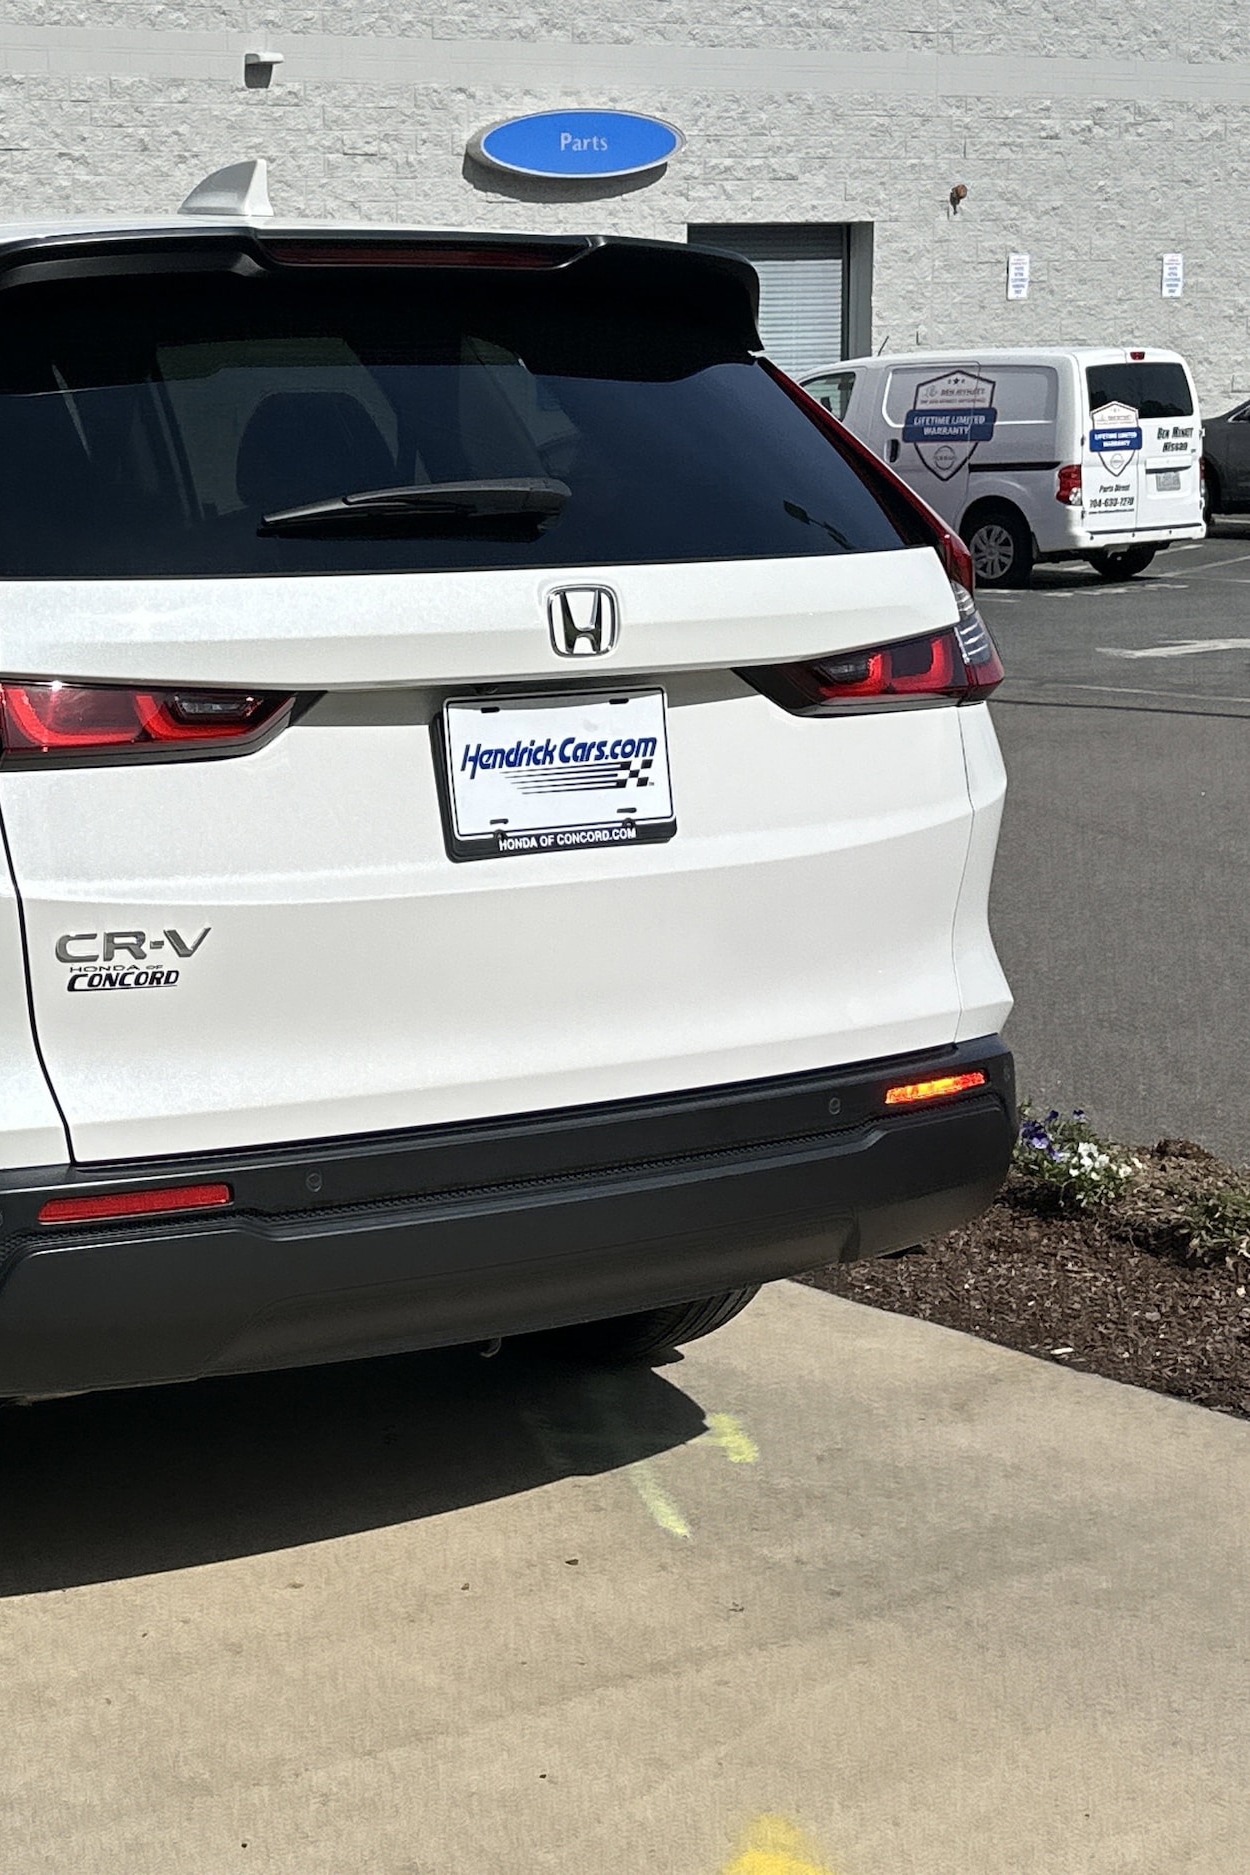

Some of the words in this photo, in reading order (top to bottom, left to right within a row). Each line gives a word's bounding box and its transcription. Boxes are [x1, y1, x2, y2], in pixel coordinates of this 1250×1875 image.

[560, 132, 608, 151] Parts
[913, 415, 950, 426] LIFETIME
[951, 415, 986, 425] LIMITED
[923, 426, 970, 436] WARRANTY
[499, 835, 538, 851] HONDA
[539, 834, 555, 847] OF
[556, 828, 637, 846] CONCORD.COM
[55, 927, 212, 963] CR-V
[70, 965, 140, 973] HONDA
[67, 970, 180, 992] CONCORD
